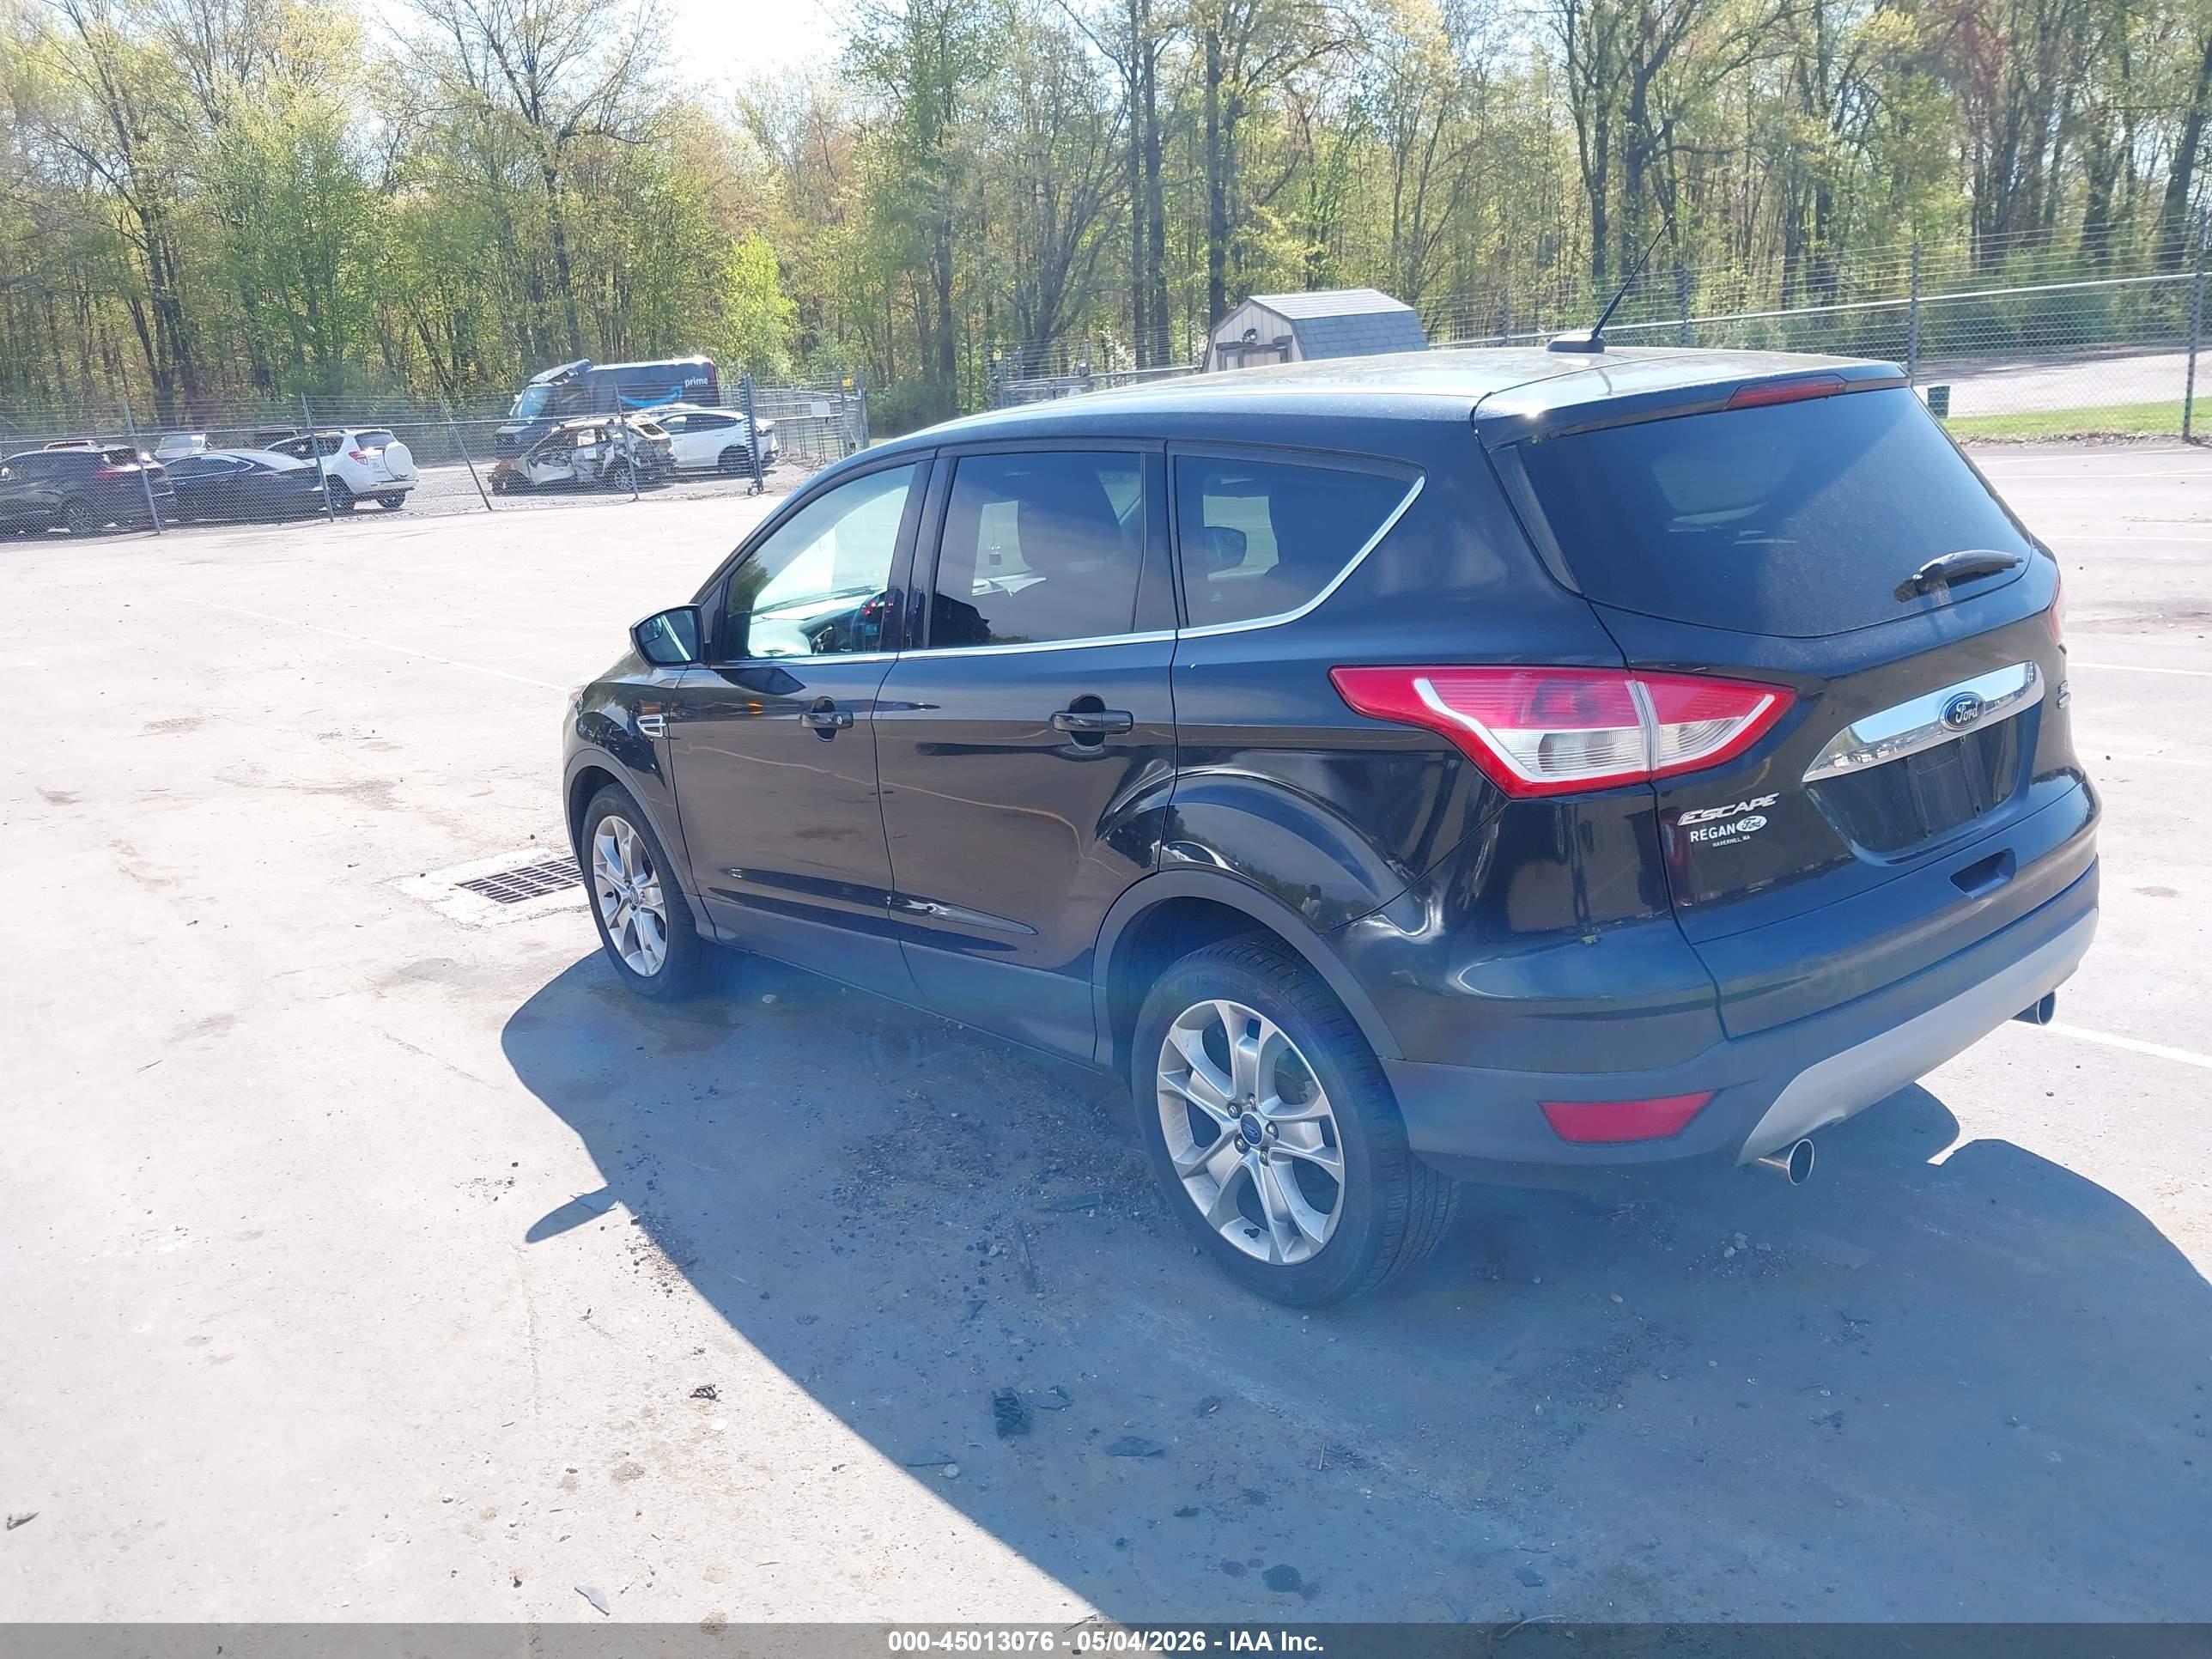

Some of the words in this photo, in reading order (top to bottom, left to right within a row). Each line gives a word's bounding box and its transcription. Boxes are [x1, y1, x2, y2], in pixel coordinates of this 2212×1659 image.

[684, 376, 708, 388] prime
[1955, 700, 1978, 723] Ford
[1677, 792, 1780, 826] ESCAPE
[1690, 823, 1736, 842] REGAN
